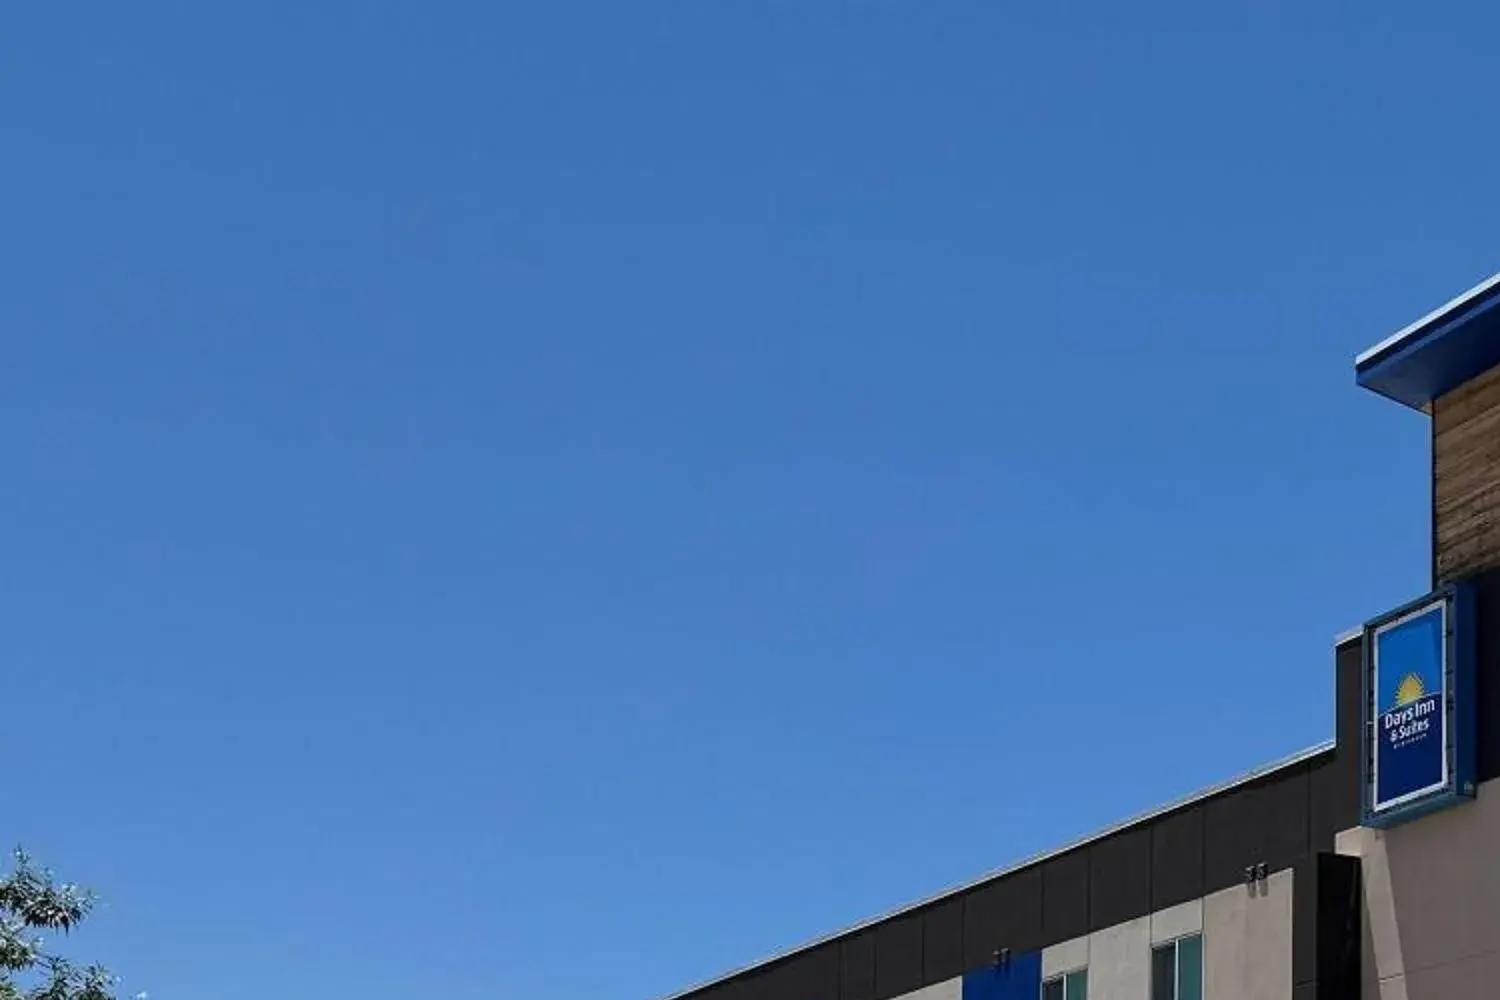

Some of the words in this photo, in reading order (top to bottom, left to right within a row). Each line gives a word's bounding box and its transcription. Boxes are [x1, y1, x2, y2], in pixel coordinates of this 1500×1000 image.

[1385, 707, 1413, 729] Days
[1415, 699, 1435, 717] Inn
[1399, 718, 1429, 739] Suites
